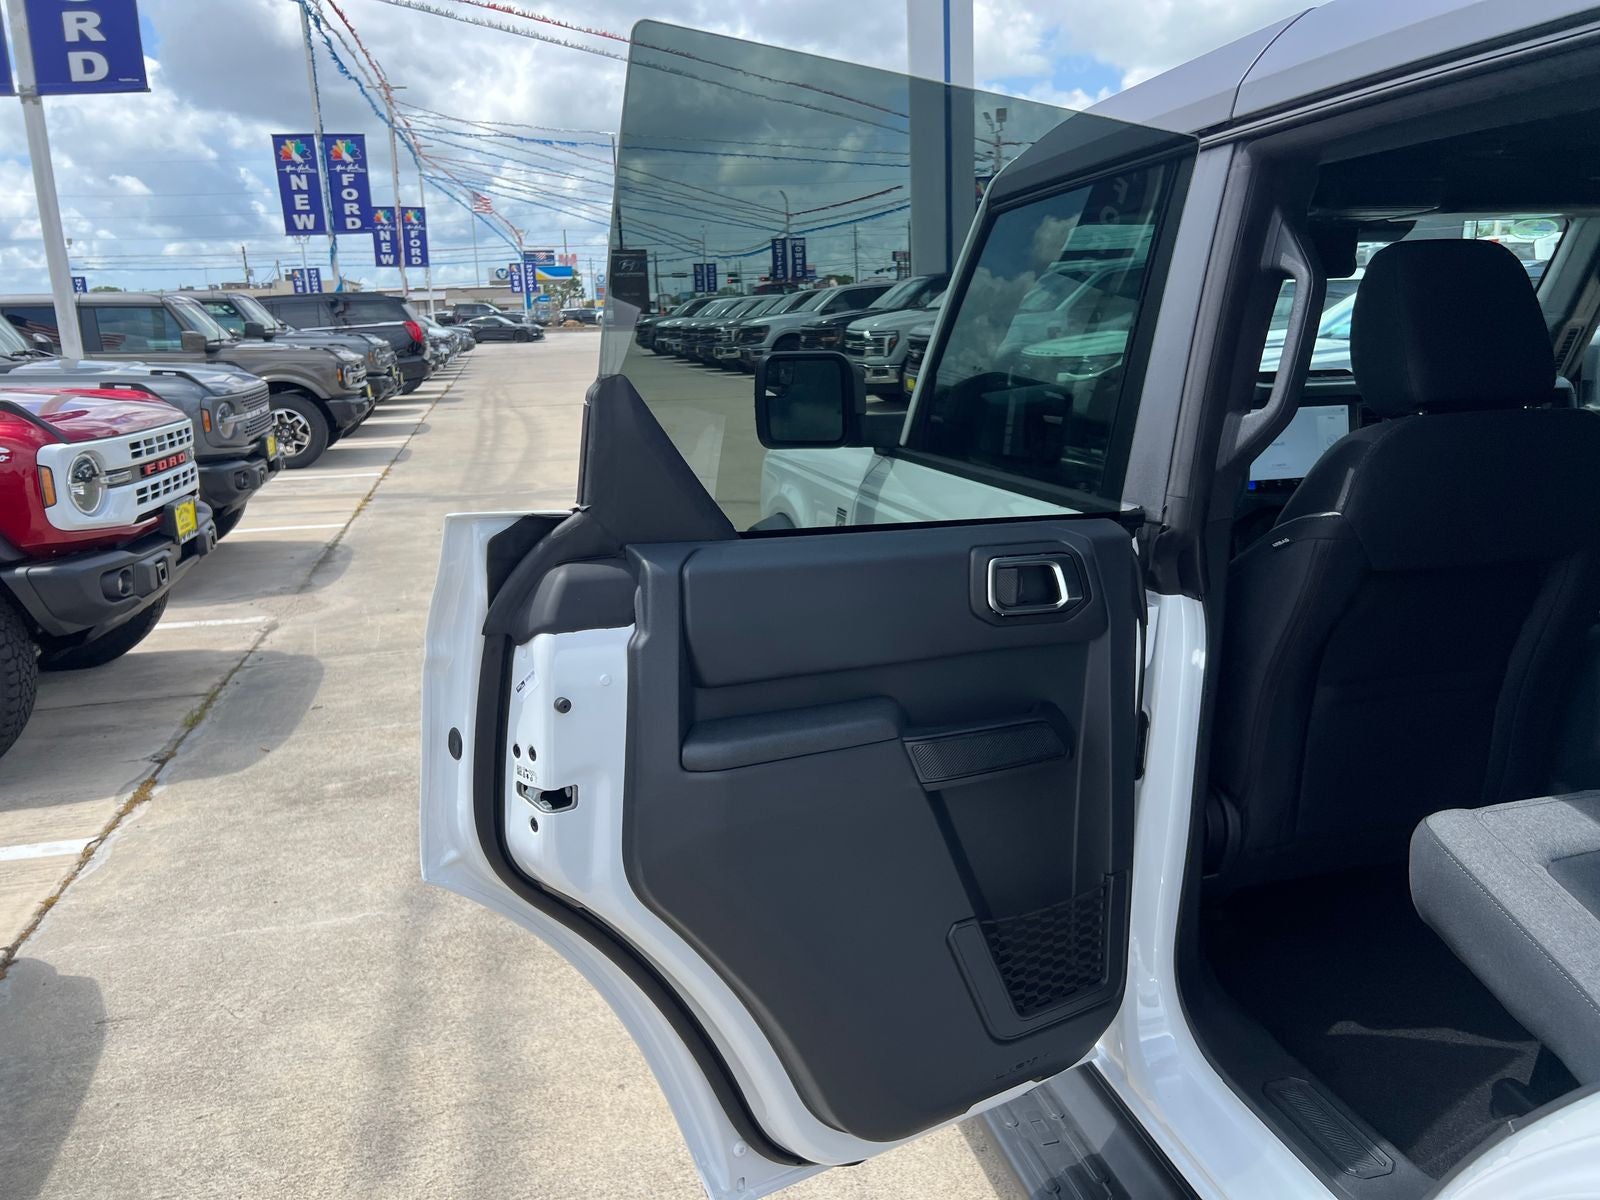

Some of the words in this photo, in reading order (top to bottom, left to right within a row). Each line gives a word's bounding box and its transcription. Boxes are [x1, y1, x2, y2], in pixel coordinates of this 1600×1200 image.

[62, 0, 109, 82] RD
[290, 174, 316, 230] NEW
[341, 174, 362, 230] FORD
[380, 230, 394, 264] NEW
[409, 230, 422, 264] FORD
[794, 246, 804, 277] OWNED
[144, 452, 186, 475] FORD
